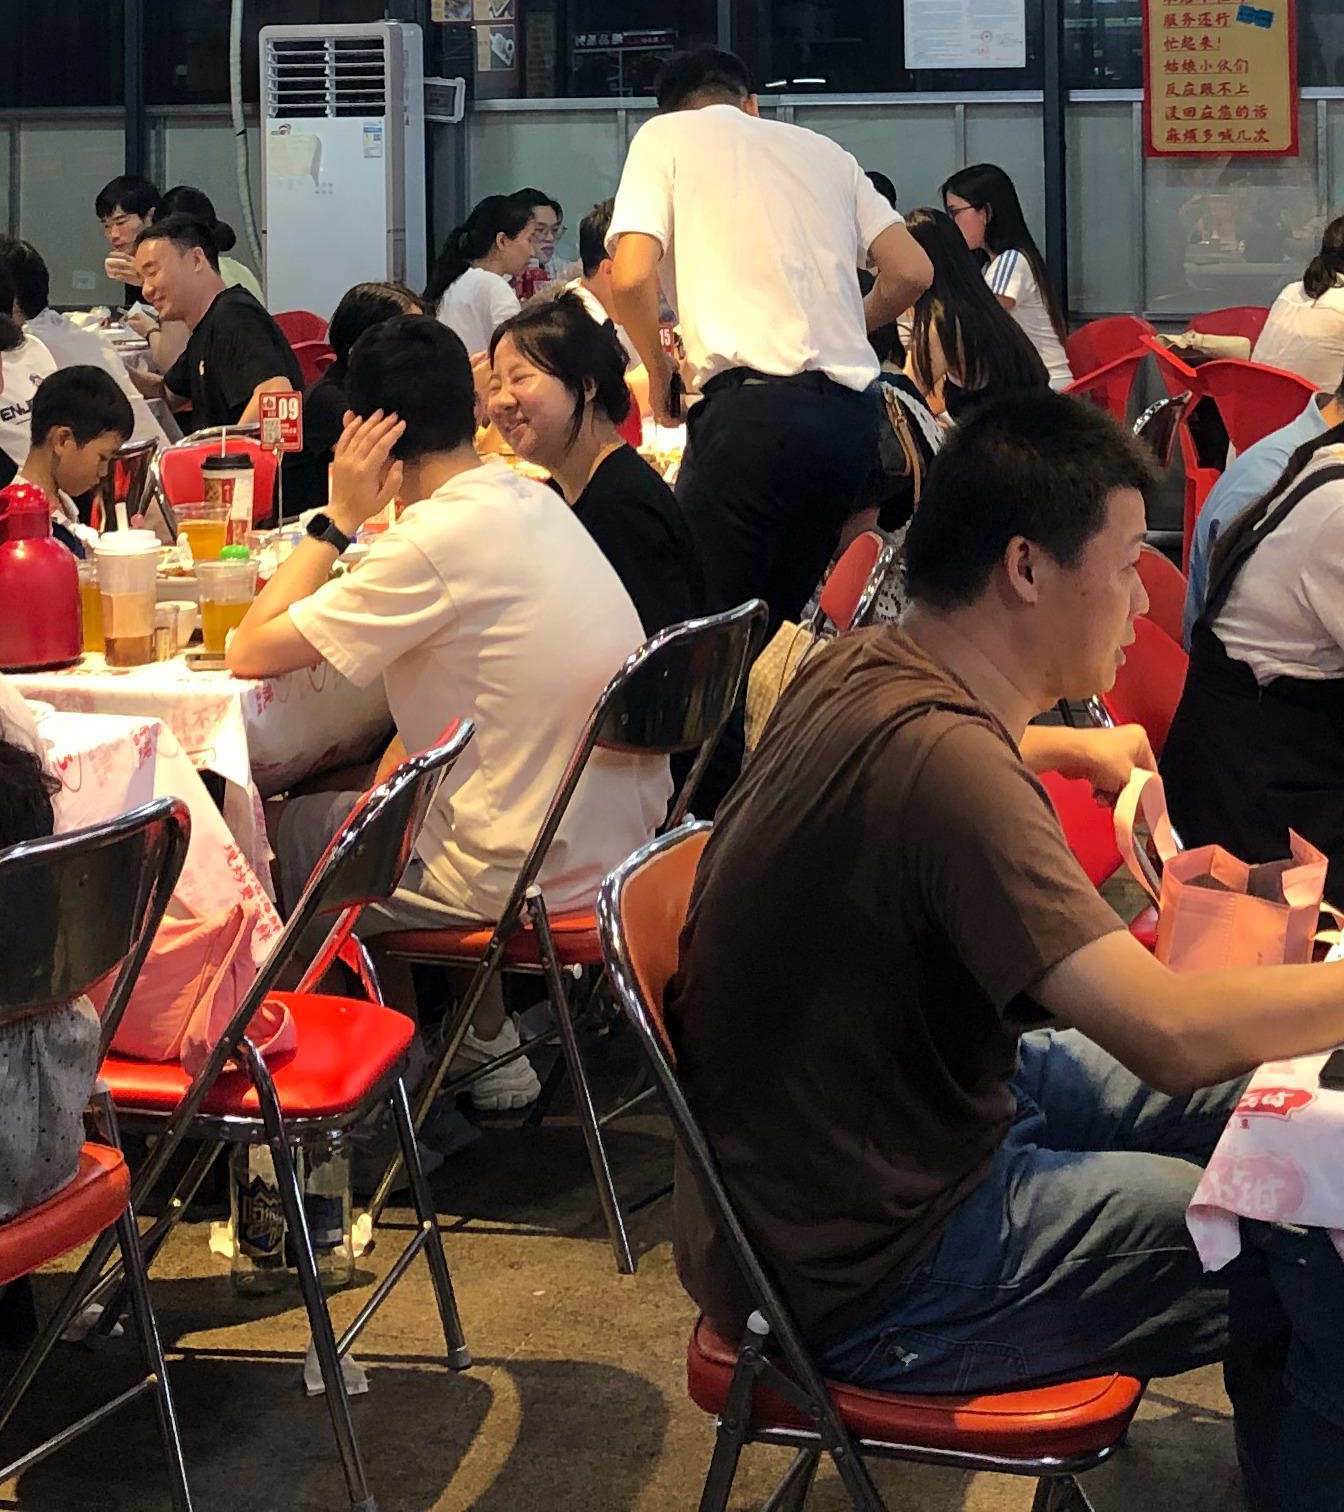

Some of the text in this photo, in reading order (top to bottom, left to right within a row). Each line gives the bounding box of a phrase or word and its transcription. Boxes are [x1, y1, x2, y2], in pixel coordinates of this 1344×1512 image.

[1162, 11, 1232, 27] 服务还行
[1163, 58, 1250, 74] 姑娘小伙们
[1164, 81, 1250, 97] 反应跟不上
[1166, 127, 1270, 144] 麻烦多喊几次
[278, 398, 299, 420] 09
